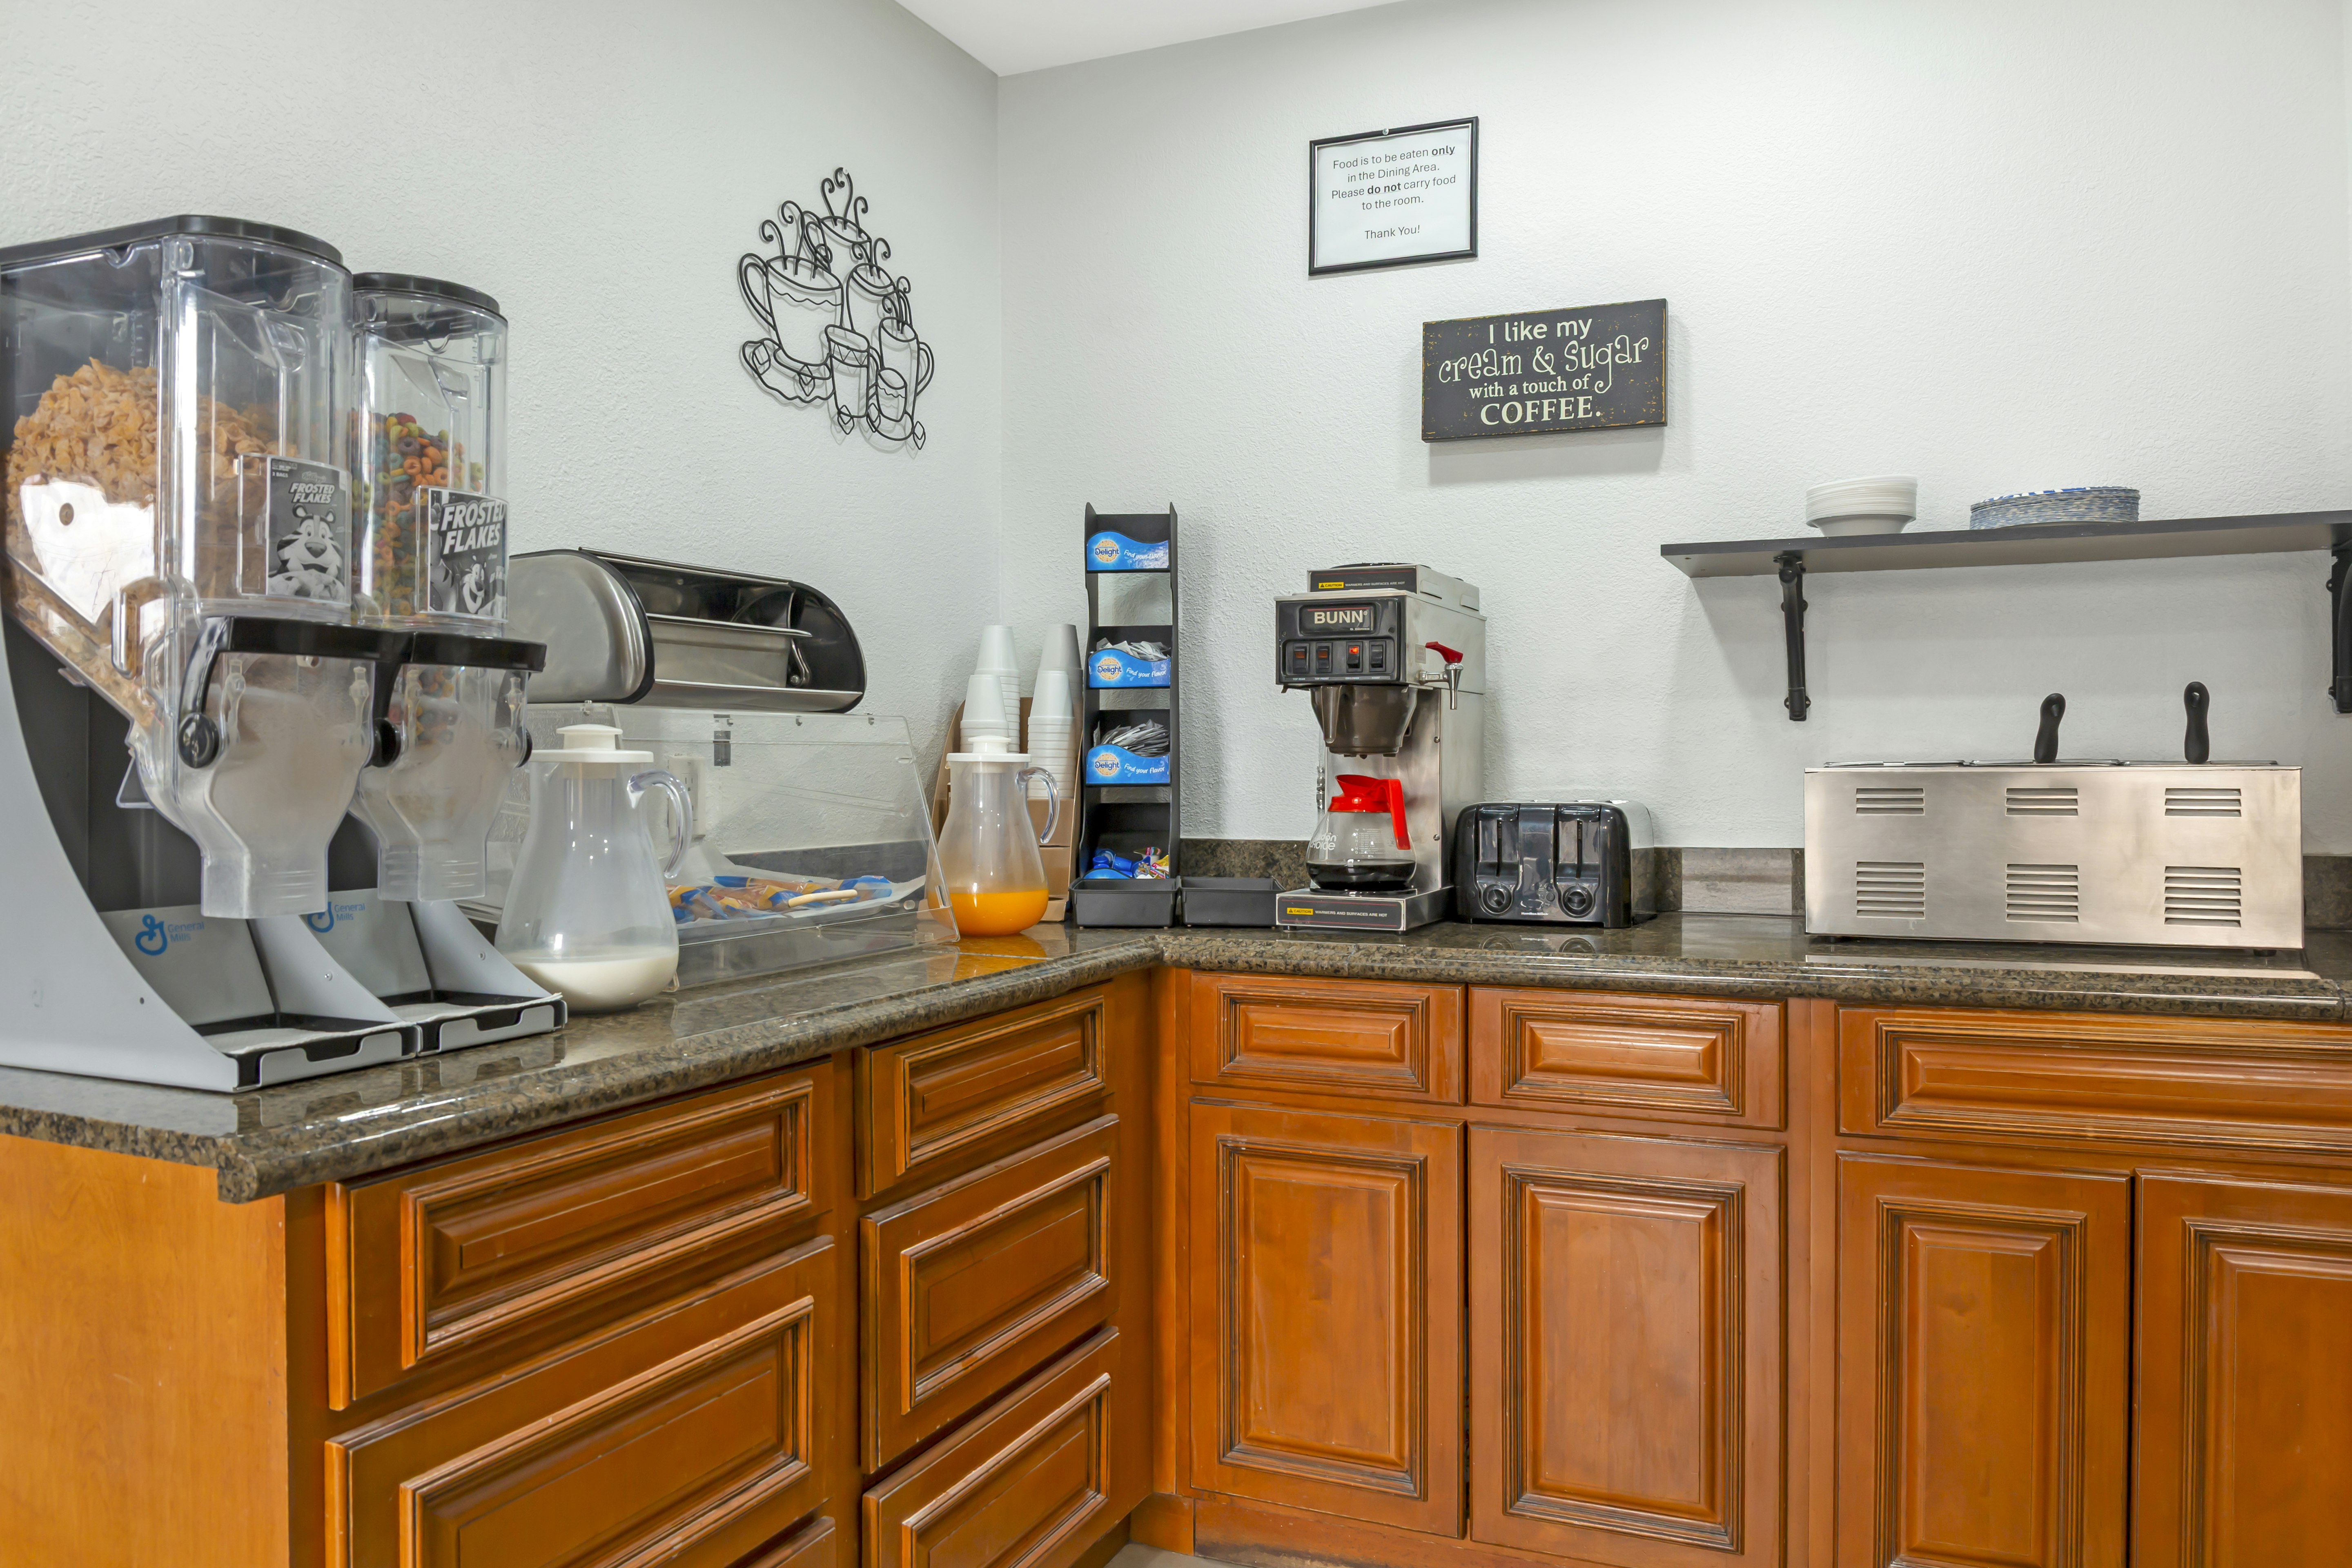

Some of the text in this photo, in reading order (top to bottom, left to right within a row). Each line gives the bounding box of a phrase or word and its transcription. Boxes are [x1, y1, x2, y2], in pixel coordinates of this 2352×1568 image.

[1333, 158, 1358, 169] Food
[1361, 157, 1368, 165] is
[1385, 154, 1396, 162] be
[1400, 149, 1428, 160] eaten
[1432, 145, 1455, 155] only
[1348, 163, 1439, 183] in the Dining Area.
[1332, 175, 1456, 199] Please do not carry food
[1362, 195, 1424, 210] to the room.
[1365, 225, 1420, 239] Thank You!
[1490, 318, 1592, 344] I like my
[1439, 349, 1522, 383] cream
[1532, 345, 1556, 375] &
[1469, 374, 1591, 399] with a touch of
[1480, 396, 1601, 425] COFFEE.
[290, 483, 334, 494] FROSTED
[293, 493, 331, 503] FLAKES
[443, 523, 500, 555] FLAKES
[1095, 548, 1119, 557] Delight
[1124, 550, 1134, 558] Find
[1314, 610, 1363, 624] BUNN
[1098, 666, 1122, 675] Delight
[1095, 762, 1120, 770] Delight
[1125, 764, 1136, 772] Find
[334, 903, 365, 912] General
[168, 922, 205, 933] General
[170, 933, 191, 942] Mills
